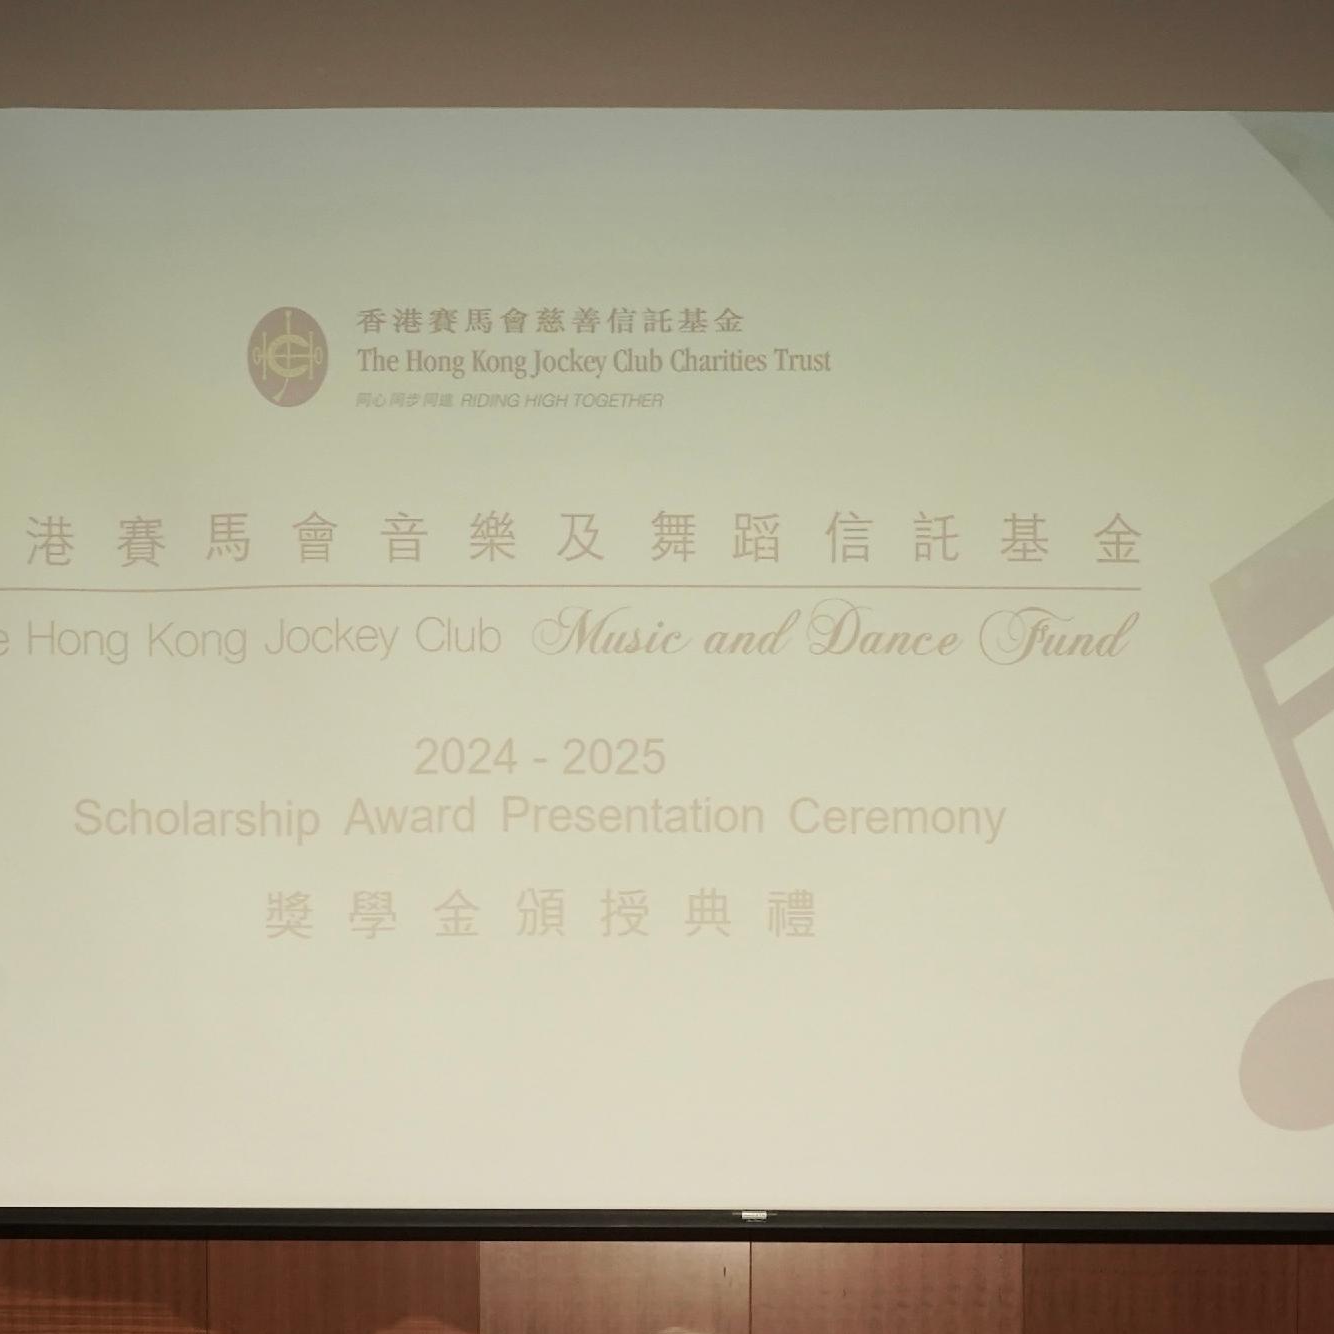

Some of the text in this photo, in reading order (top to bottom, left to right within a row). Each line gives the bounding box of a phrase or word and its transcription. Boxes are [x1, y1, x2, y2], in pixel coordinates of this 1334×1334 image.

[357, 307, 746, 335] 香港賽馬會慈善信託基金
[357, 347, 833, 381] The Hong Kong Jockey Club Charities Trust
[461, 393, 520, 408] RIDING
[524, 393, 568, 408] HIGH
[574, 393, 665, 408] TOGETHER
[27, 619, 130, 667] Hong
[149, 621, 249, 667] Kong
[264, 616, 401, 664] Jockey
[415, 615, 503, 655] Club
[531, 605, 691, 656] Music
[703, 608, 801, 656] and
[805, 598, 964, 657] Dance
[979, 606, 1142, 667] Fund
[414, 737, 519, 777] 2024
[563, 737, 668, 777] 2025
[73, 795, 1009, 849] Scholarship Award Presentation Ceremony
[265, 886, 818, 943] 獎學金頒授典禮
